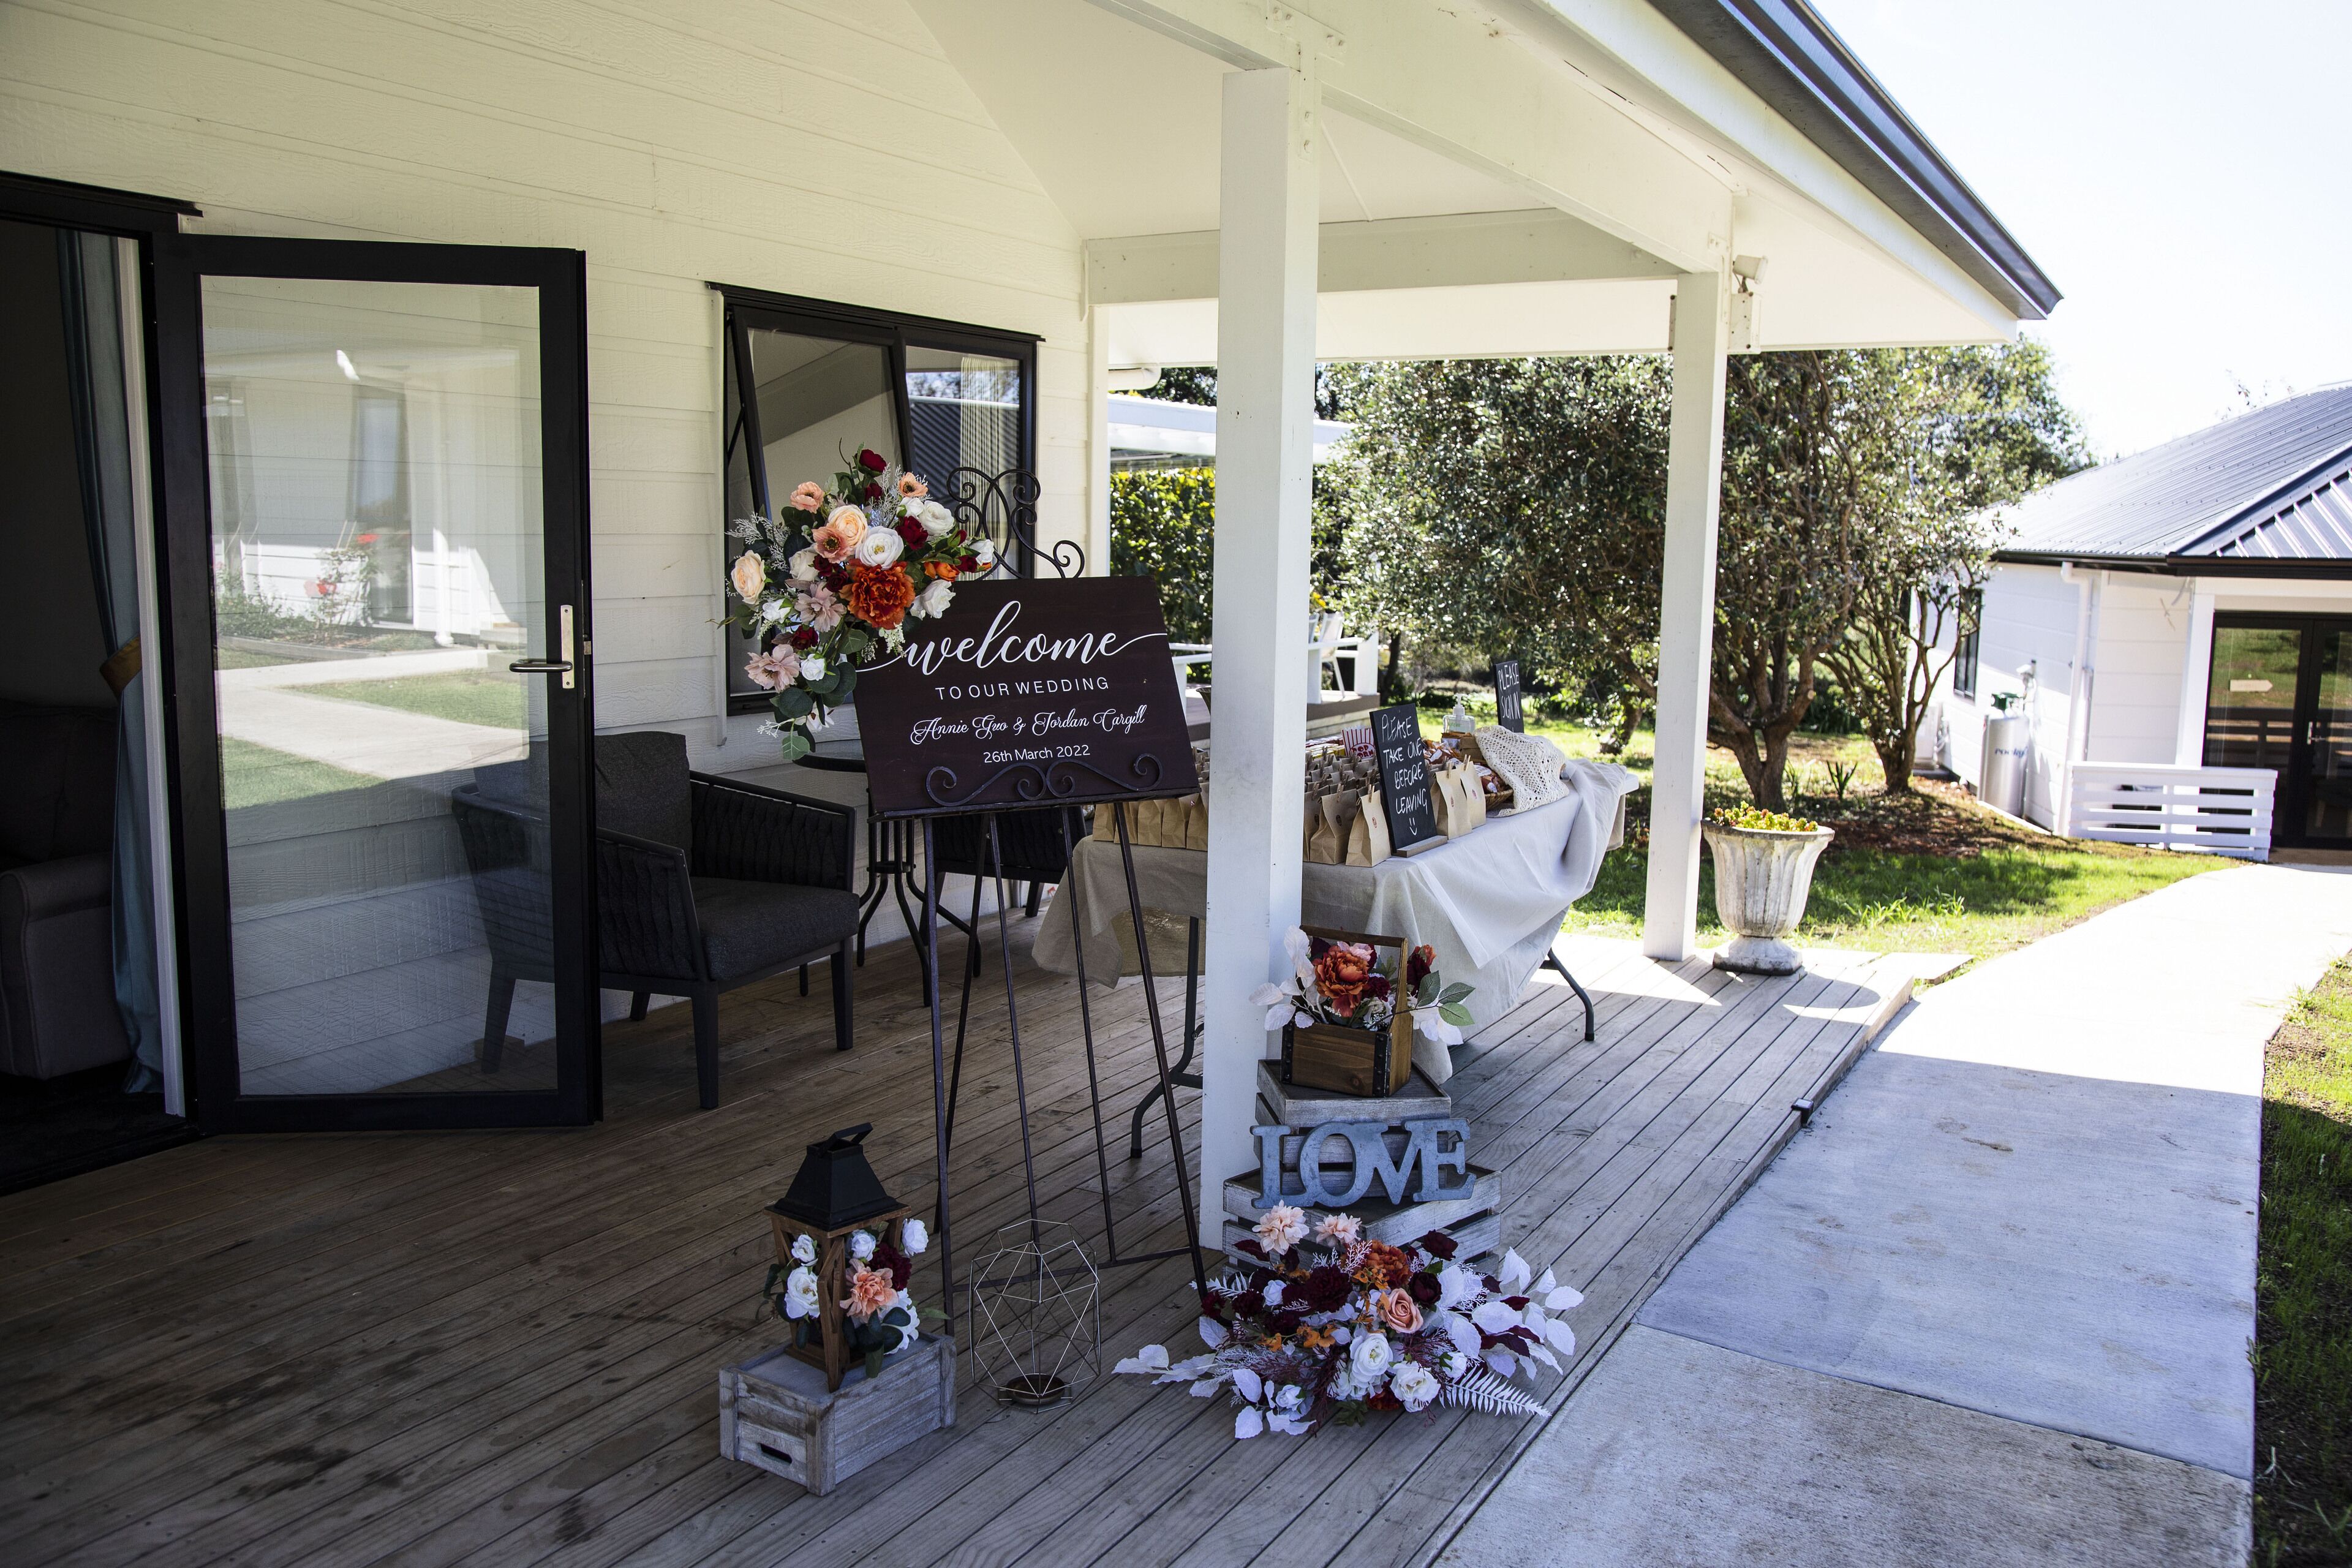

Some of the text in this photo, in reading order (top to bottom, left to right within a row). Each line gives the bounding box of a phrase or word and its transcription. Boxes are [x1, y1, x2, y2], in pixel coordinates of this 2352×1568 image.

[855, 600, 1167, 676] welcome
[935, 676, 1109, 700] TO OUR WEDDING
[1498, 663, 1520, 693] PLEASE
[1501, 690, 1521, 720] SIGN IN
[910, 704, 1147, 745] Annie Guo & Jordan Cargill
[1381, 714, 1412, 743] PLEASE
[983, 744, 1091, 763] 26th March 2022
[1355, 749, 1374, 758] ORN
[1383, 737, 1422, 769] TAKE ONE
[1394, 762, 1423, 790] BEFORE
[1395, 788, 1428, 815] LEAVING
[1250, 1117, 1477, 1209] LOVE
